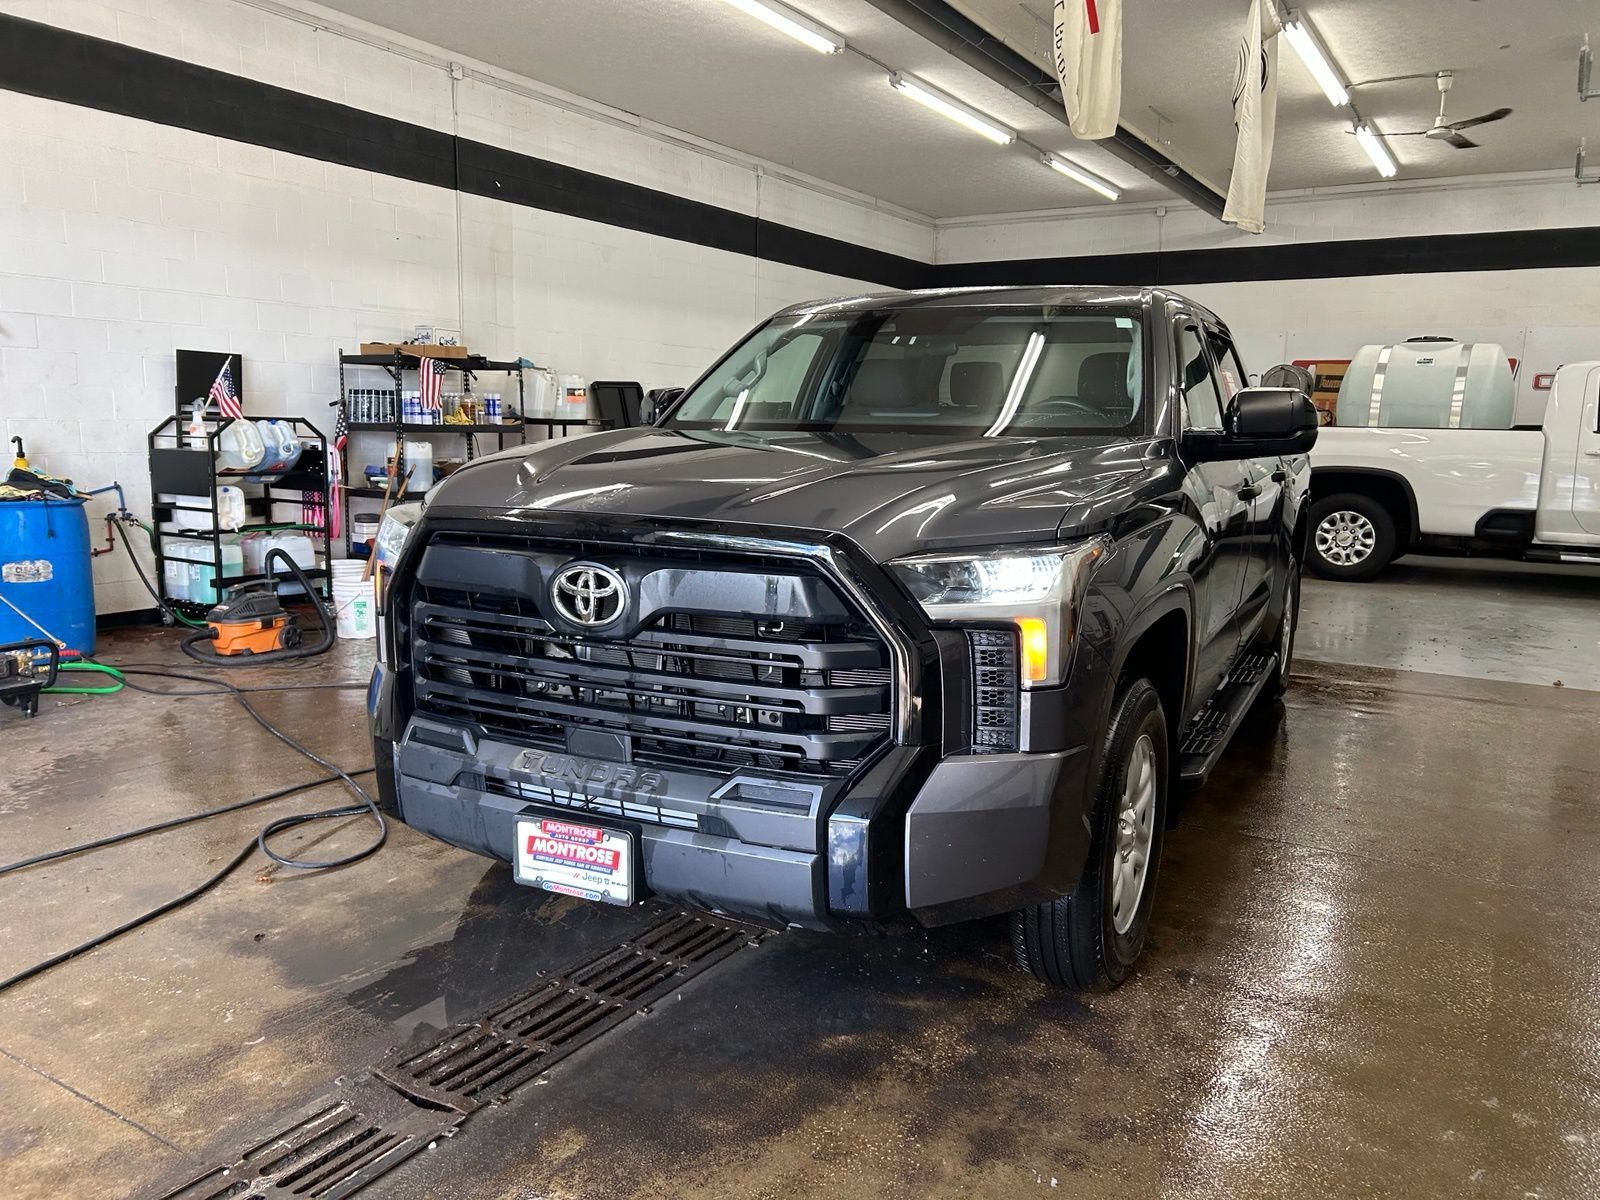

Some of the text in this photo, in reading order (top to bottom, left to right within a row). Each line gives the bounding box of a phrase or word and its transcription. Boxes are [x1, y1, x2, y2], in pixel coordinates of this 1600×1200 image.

[521, 751, 666, 791] TUNDRA
[545, 823, 598, 839] MONTROSE
[532, 839, 614, 865] MONTROSE
[582, 872, 603, 885] Jeep
[543, 882, 600, 900] GoMontrose.com
